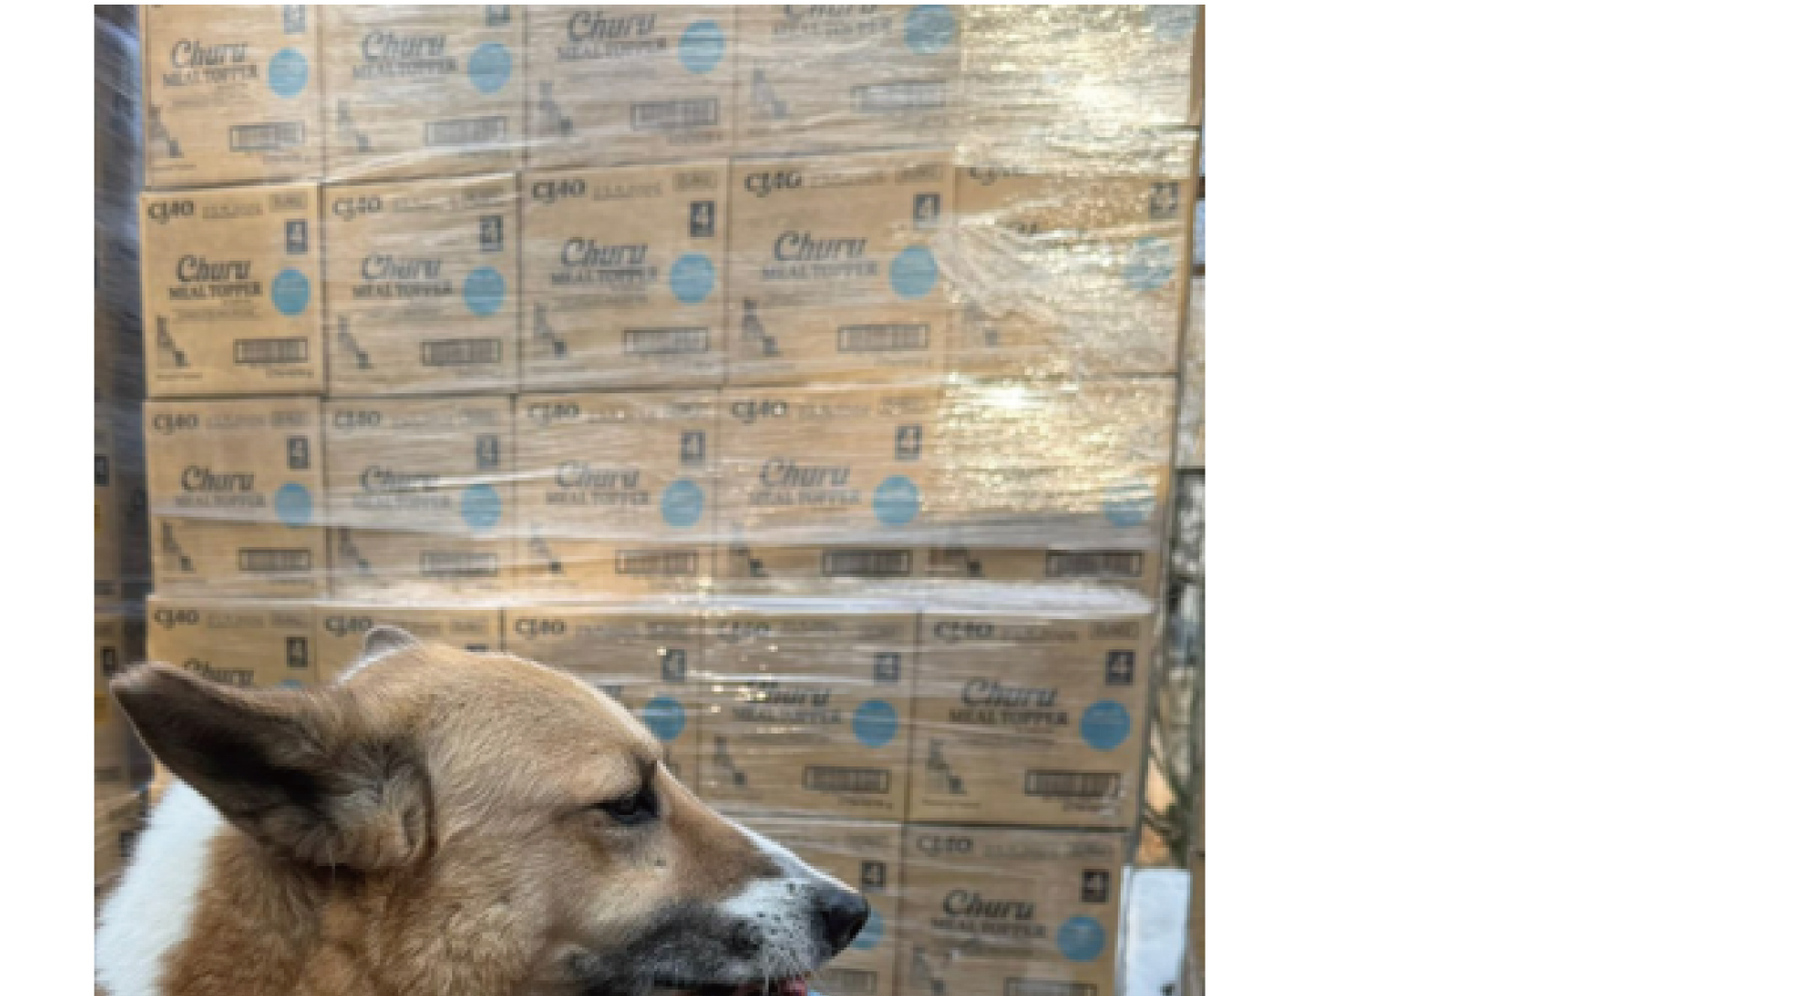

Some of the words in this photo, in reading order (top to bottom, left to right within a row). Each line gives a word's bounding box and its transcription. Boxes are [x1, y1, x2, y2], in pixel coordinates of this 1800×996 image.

[566, 10, 657, 43] Churu
[171, 39, 248, 68] Churu
[361, 29, 446, 61] Churu
[560, 236, 648, 268] Churu
[774, 231, 867, 263] Churu
[176, 254, 251, 283] Churu
[361, 253, 442, 283] Churu
[168, 285, 205, 301] MEAL
[207, 281, 262, 299] TOPPER
[181, 466, 254, 492] Churu
[556, 460, 641, 490] Churu
[760, 457, 850, 488] Churu
[961, 678, 1057, 709] Churu
[949, 708, 997, 726] MEAL
[999, 708, 1068, 728] TOPPER
[943, 889, 1035, 921] Churu
